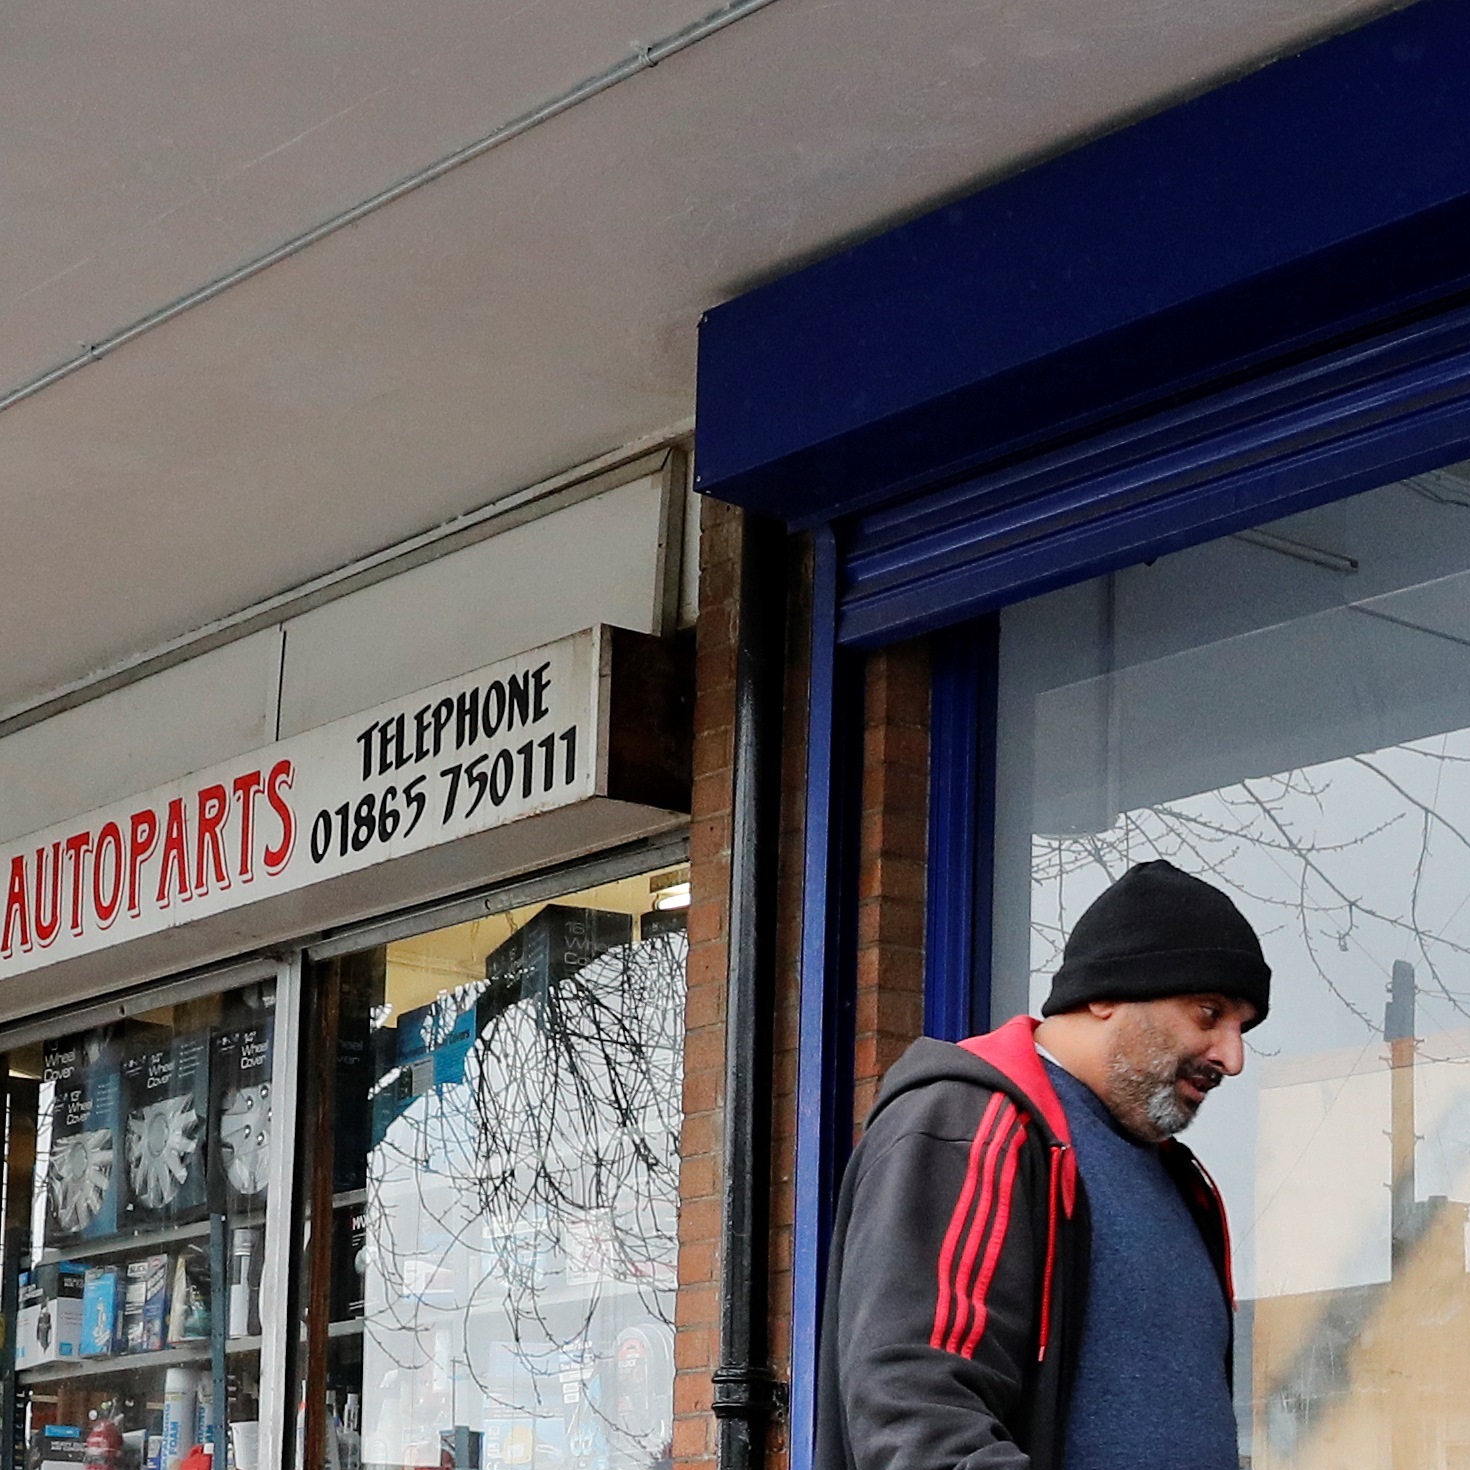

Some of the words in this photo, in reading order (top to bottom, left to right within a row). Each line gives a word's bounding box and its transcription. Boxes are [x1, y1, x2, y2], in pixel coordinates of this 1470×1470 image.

[357, 661, 551, 781] TELEPHONE
[310, 773, 427, 863] 01865
[440, 725, 577, 823] 750111
[0, 759, 296, 959] AUTOPARTS
[241, 1040, 269, 1056] Wheel
[44, 1047, 76, 1067] Wheel
[240, 1054, 267, 1070] Cover
[44, 1066, 75, 1082] Cover
[148, 1061, 175, 1077] Wheel
[147, 1073, 172, 1089] Cover
[68, 1099, 93, 1113] Wheel
[66, 1111, 91, 1125] Cover
[168, 1421, 179, 1456] FOAM
